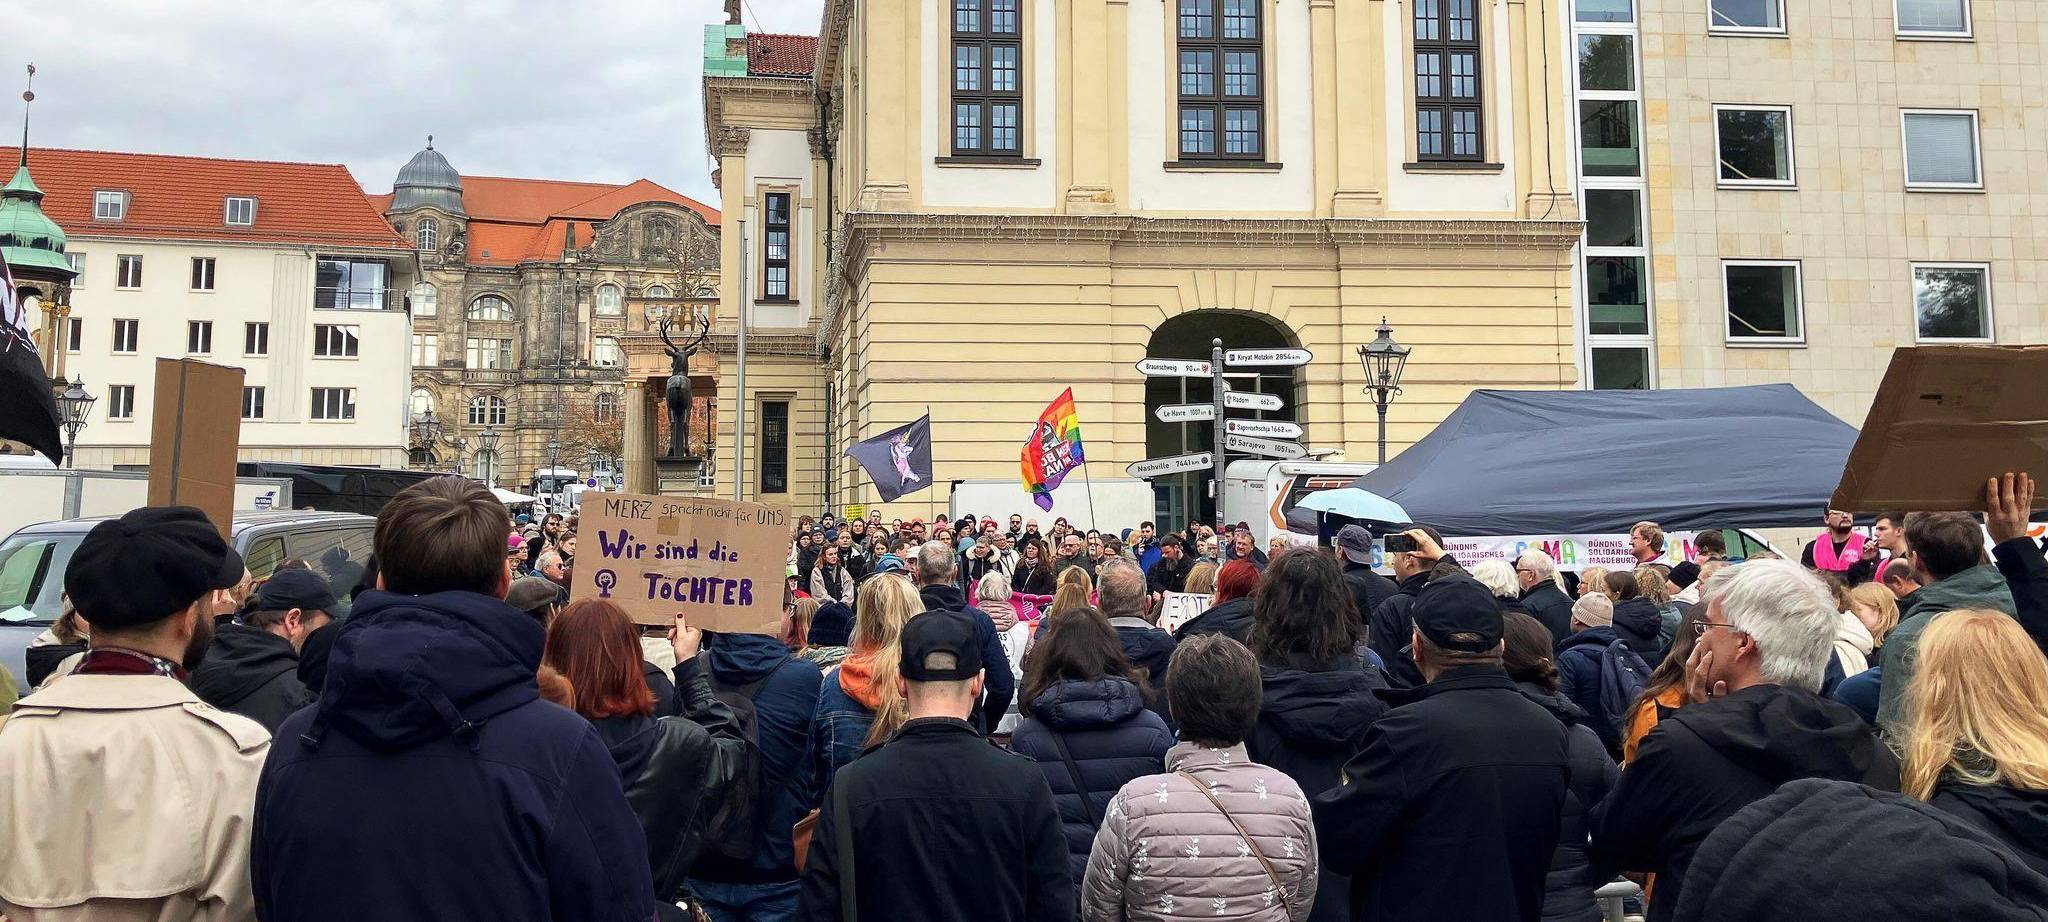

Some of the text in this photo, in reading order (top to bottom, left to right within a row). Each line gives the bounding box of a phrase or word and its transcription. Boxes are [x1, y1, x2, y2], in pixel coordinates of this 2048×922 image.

[1237, 353, 1253, 361] Kiryat
[1145, 362, 1178, 373] Braunschweig
[1185, 364, 1194, 372] 90
[1232, 395, 1250, 404] Radom
[1171, 409, 1186, 417] Havre
[1271, 425, 1285, 433] 1662
[1237, 439, 1266, 450] Sarajevo
[1274, 444, 1288, 454] 1051
[1137, 461, 1170, 472] Nashville
[1175, 459, 1191, 468] 7441
[604, 498, 787, 527] MERZ spricht nicht für UNS.
[598, 528, 739, 562] Wir sind die
[1443, 542, 1478, 551] BÜNDNIS
[1588, 539, 1623, 548] BÜNDNIS
[1447, 551, 1505, 559] OLIDARISCHES
[643, 572, 753, 606] TÖCHTER
